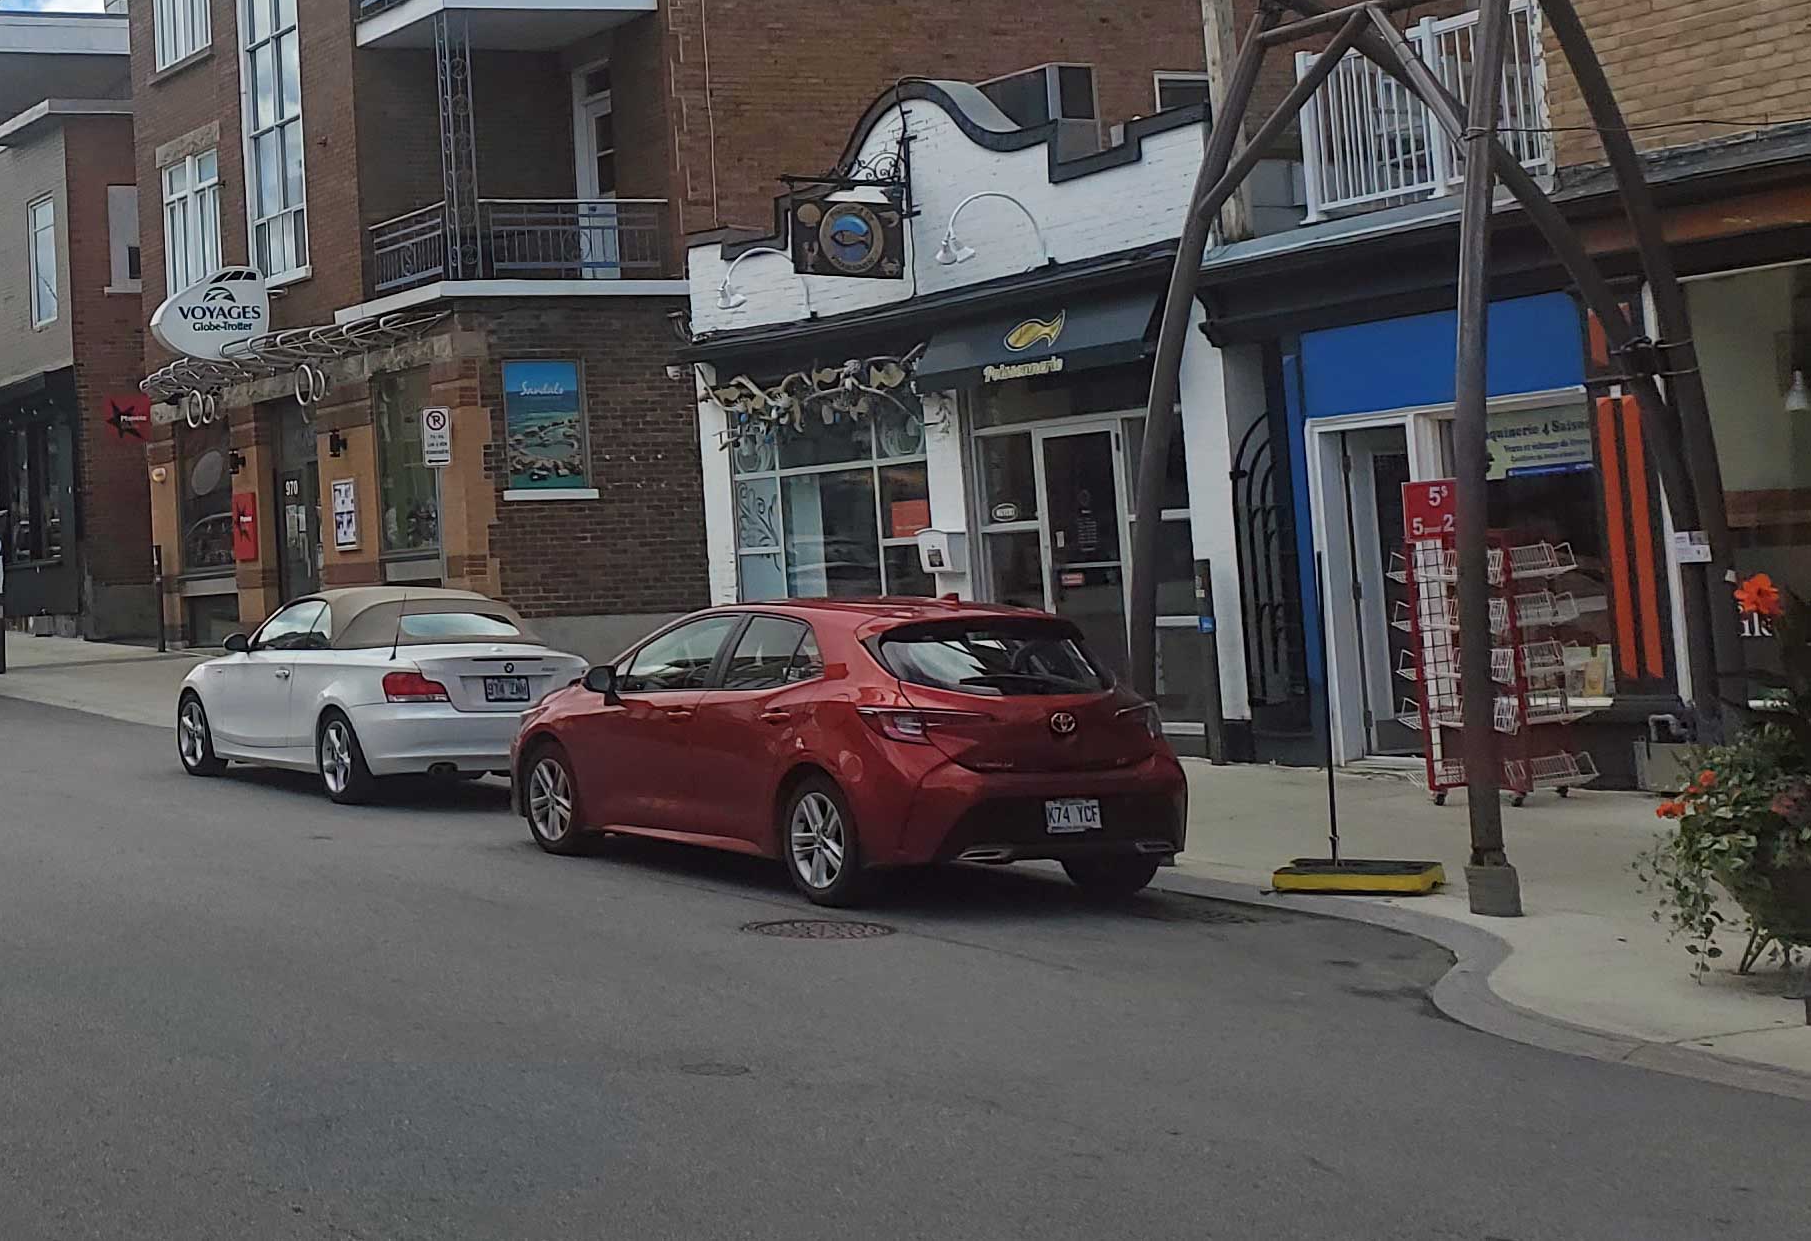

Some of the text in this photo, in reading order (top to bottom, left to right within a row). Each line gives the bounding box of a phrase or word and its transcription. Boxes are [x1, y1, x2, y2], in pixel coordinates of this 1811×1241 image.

[178, 306, 261, 319] VOYAGES
[192, 321, 253, 331] Globe-Trotter
[982, 356, 1064, 383] Poissonnerie
[285, 480, 299, 496] 970
[1412, 517, 1424, 535] 5
[1048, 804, 1098, 824] K74 YCF
